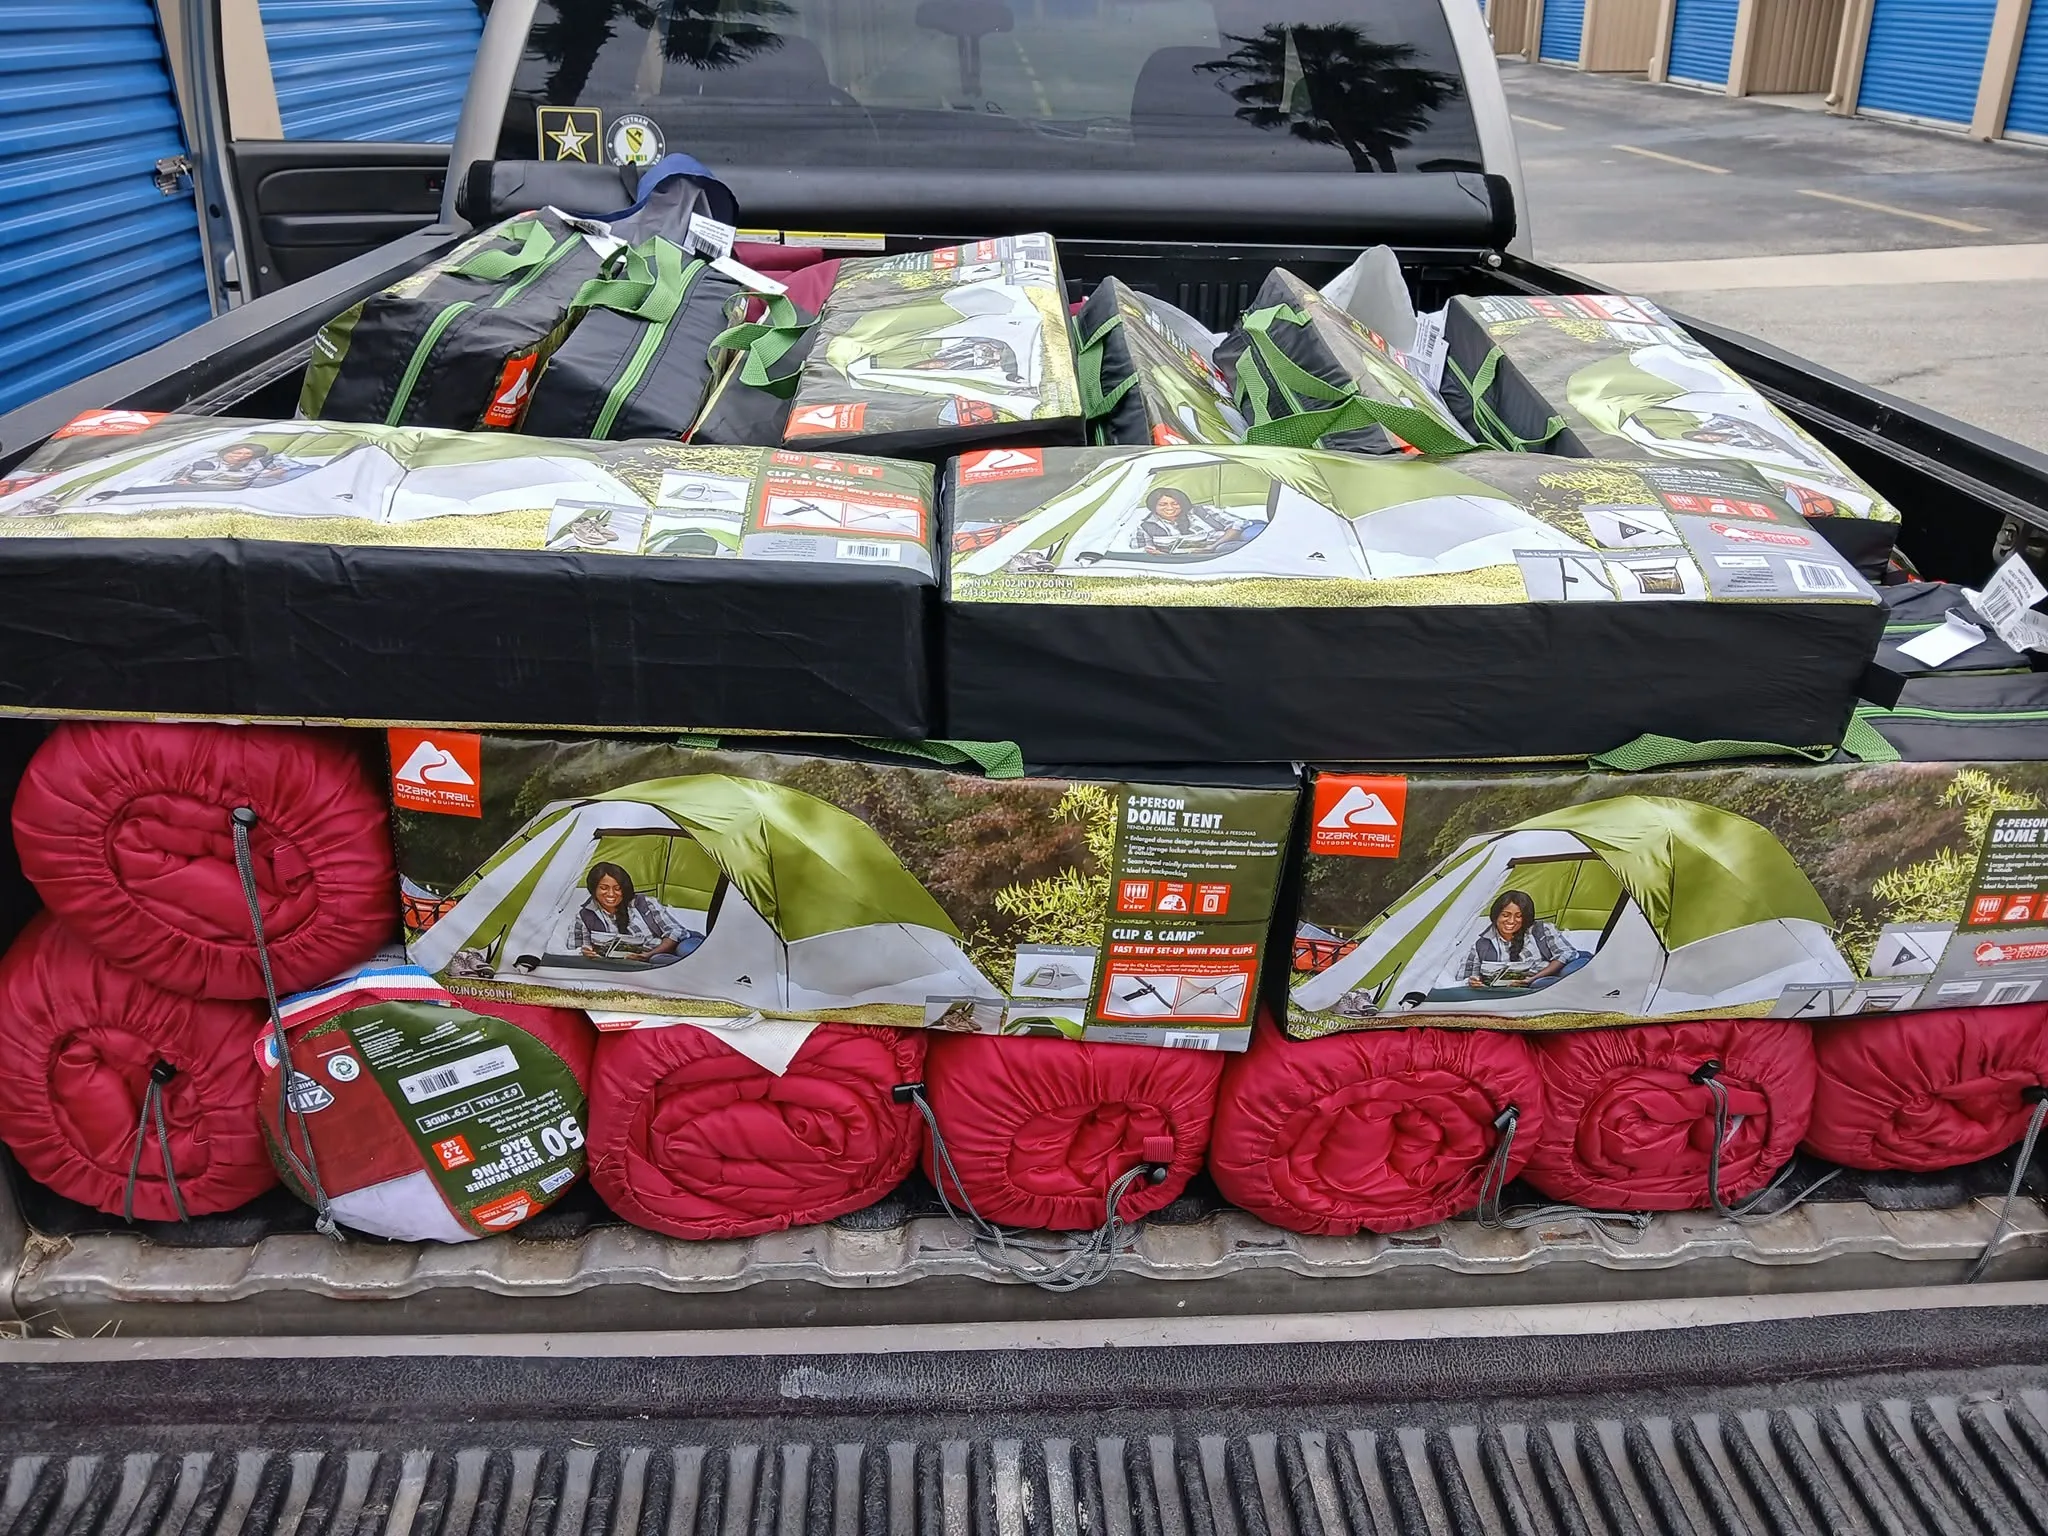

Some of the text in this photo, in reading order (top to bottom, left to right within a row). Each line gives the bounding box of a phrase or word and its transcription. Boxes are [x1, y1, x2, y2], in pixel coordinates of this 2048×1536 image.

[619, 116, 649, 126] VIETNAM
[397, 783, 474, 803] OZARK TRAIL
[397, 793, 475, 808] OUTDOOR EQUIPMENT
[1127, 795, 1185, 811] 4-PERSON
[1127, 808, 1223, 829] DOME TENT
[1996, 818, 2047, 828] 4-PERSON
[1130, 835, 1156, 843] Enlarged
[1174, 838, 1193, 846] design
[1317, 832, 1395, 842] OZARK TRAIL
[1992, 829, 2039, 843] DOME
[1151, 867, 1187, 877] backpacking
[1182, 861, 1204, 869] protects
[1112, 928, 1140, 940] CLIP
[1143, 930, 1153, 940] &
[1114, 945, 1133, 953] FAST
[1232, 946, 1253, 954] CLIPS
[476, 1095, 498, 1109] TALL
[424, 1112, 451, 1129] WIDE
[441, 1139, 457, 1151] LBS
[443, 1145, 464, 1159] 2.9
[500, 1135, 533, 1156] BAG
[471, 1146, 539, 1180] SLEEPING
[465, 1157, 545, 1193] WARM WEATHER
[552, 1171, 572, 1183] USA
